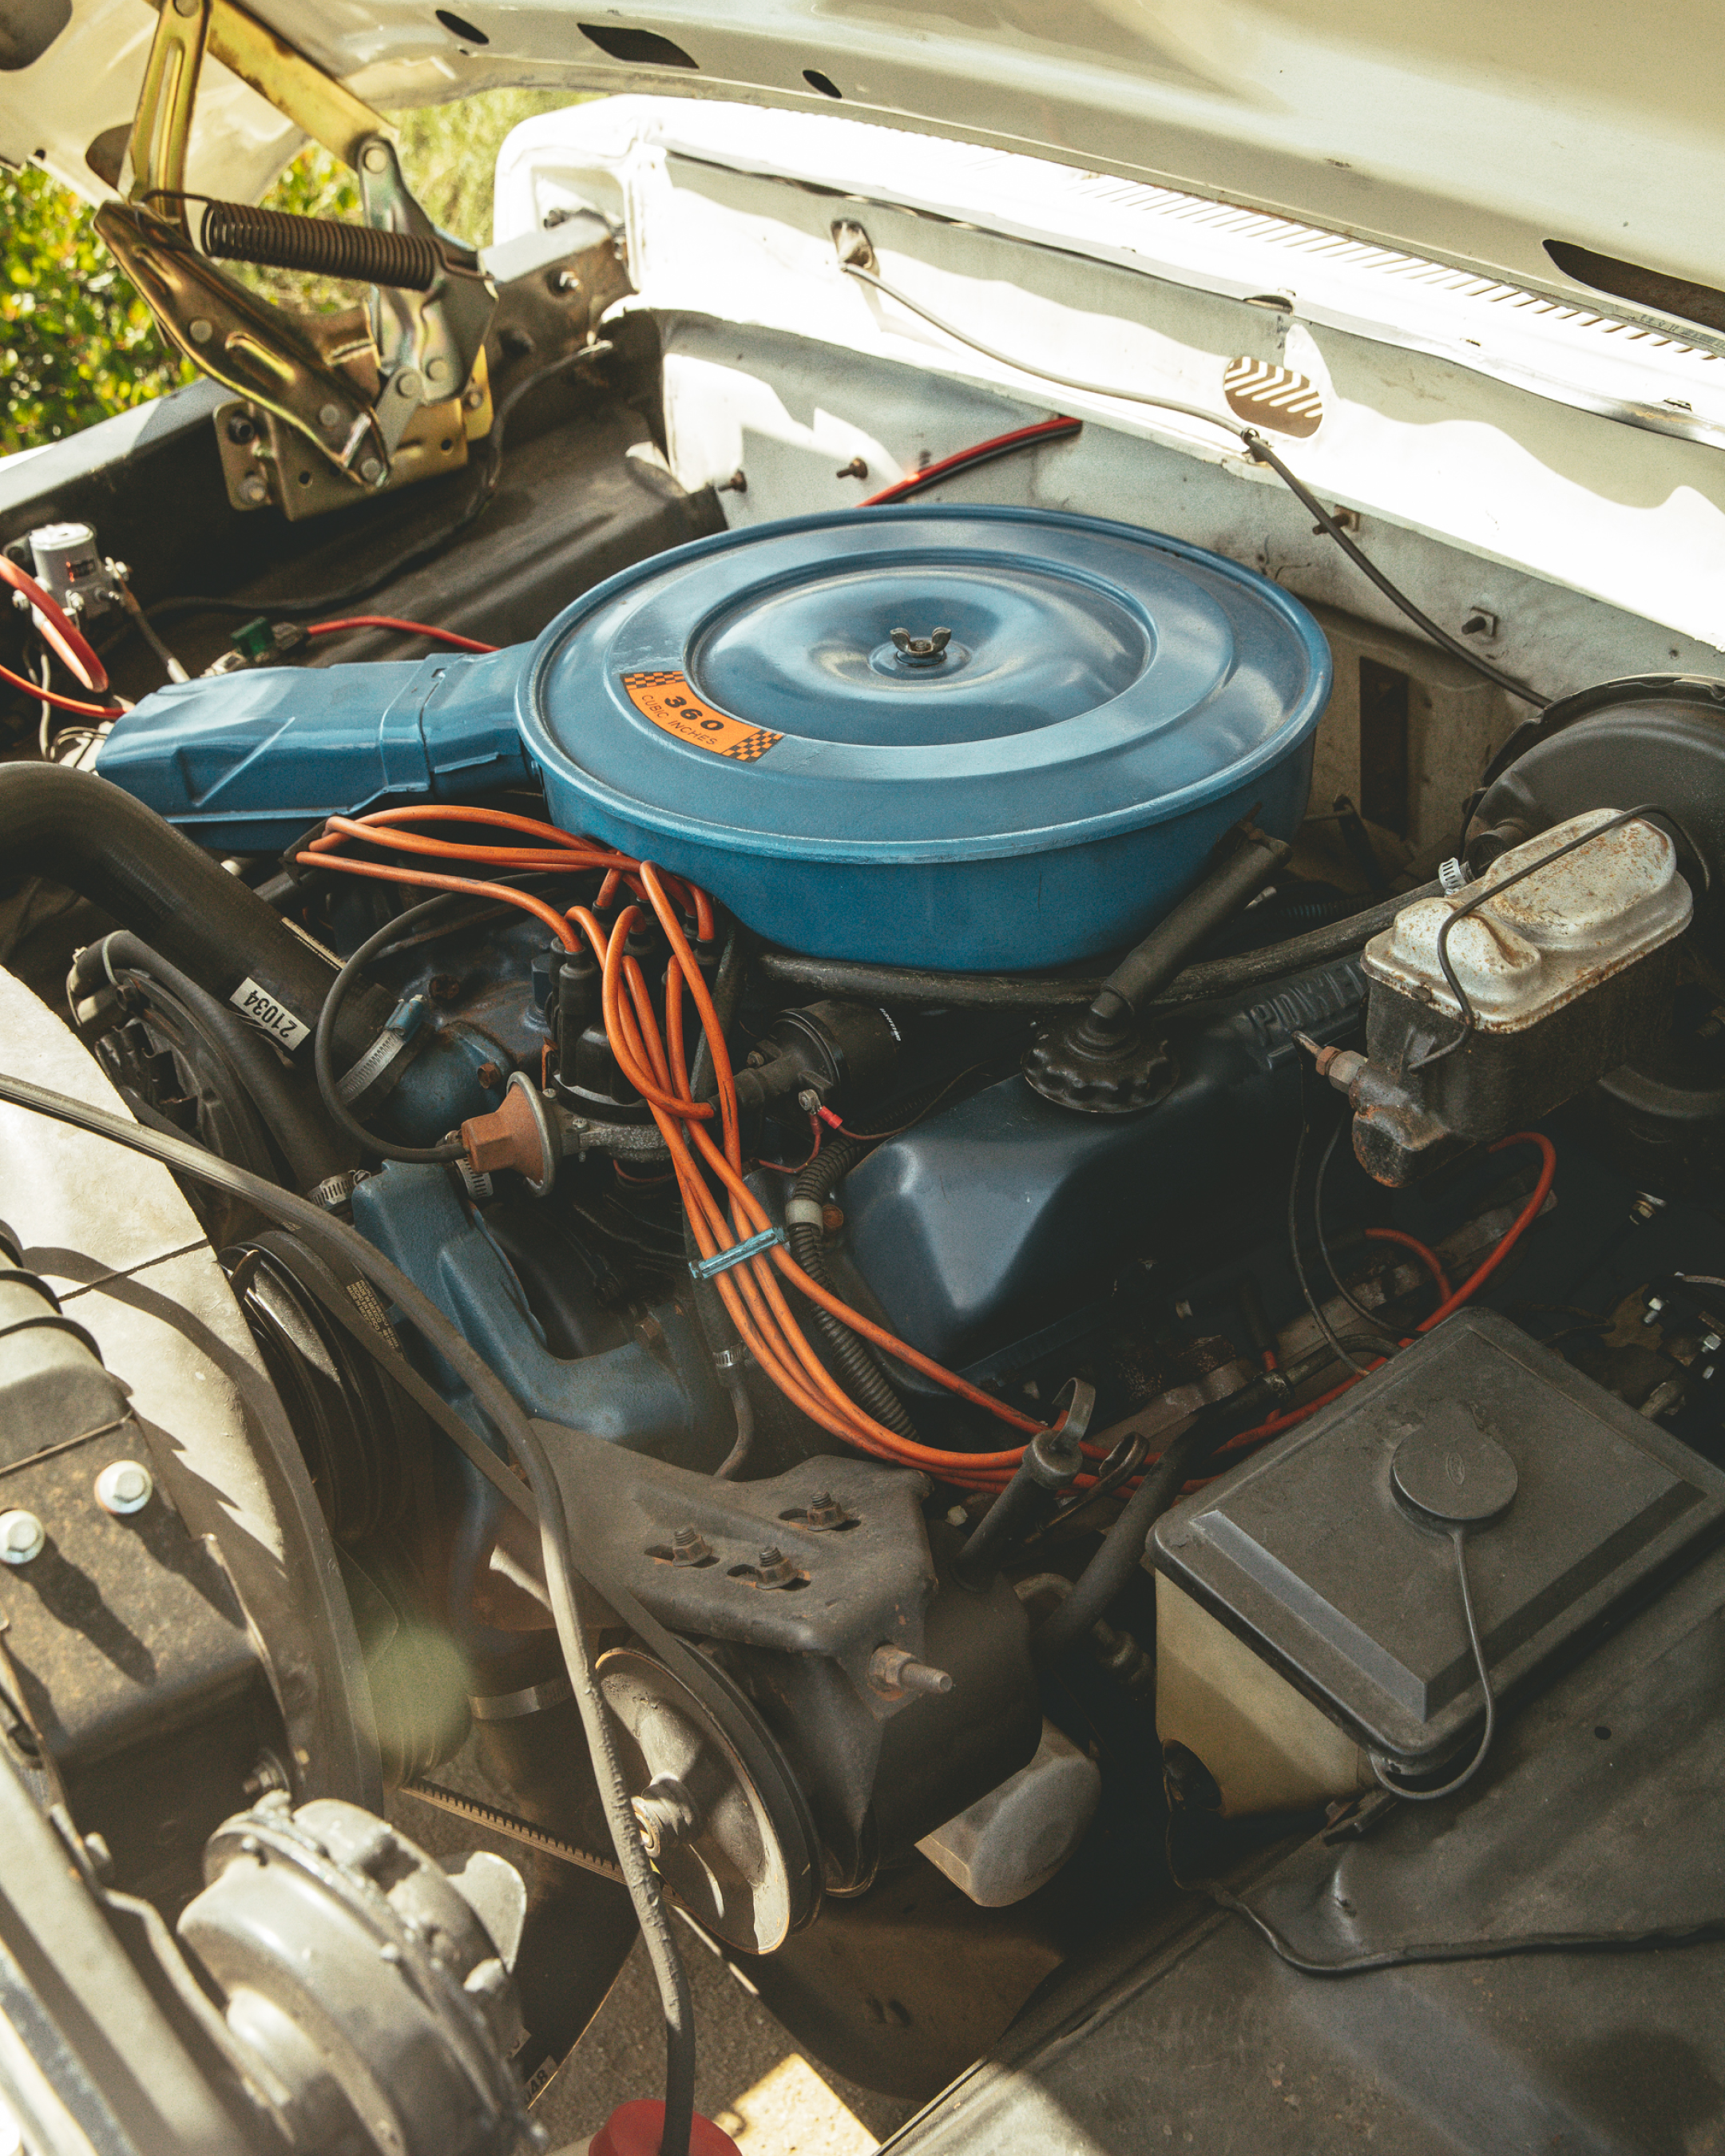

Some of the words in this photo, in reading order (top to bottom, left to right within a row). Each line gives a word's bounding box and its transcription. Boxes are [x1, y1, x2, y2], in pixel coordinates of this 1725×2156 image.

[641, 694, 669, 718] CUBIC
[668, 719, 717, 746] INCHES
[664, 696, 724, 731] 360
[243, 989, 298, 1038] 21034
[346, 1286, 358, 1300] MADE
[355, 1281, 367, 1296] MADE
[368, 1302, 382, 1323] MEXICO
[361, 1301, 368, 1310] EN
[366, 1310, 380, 1330] MEXICO
